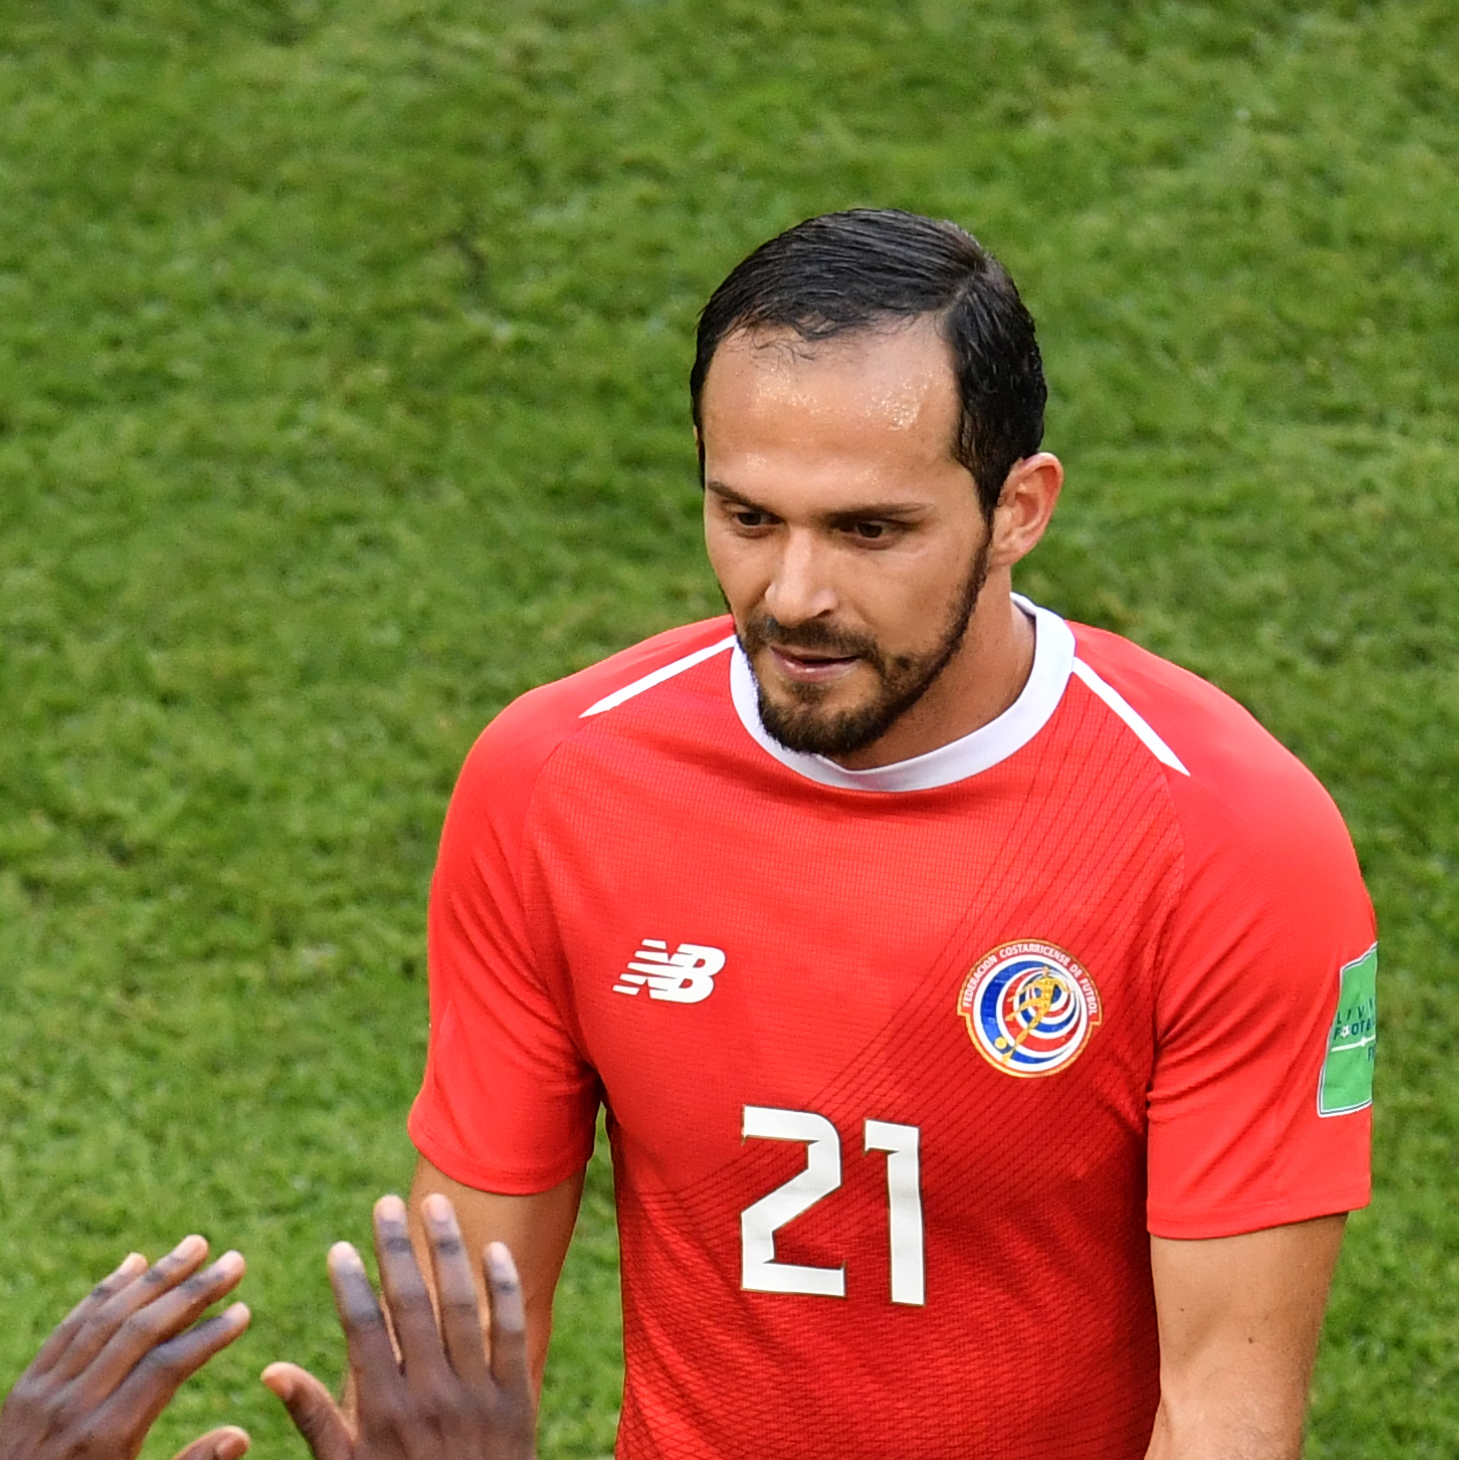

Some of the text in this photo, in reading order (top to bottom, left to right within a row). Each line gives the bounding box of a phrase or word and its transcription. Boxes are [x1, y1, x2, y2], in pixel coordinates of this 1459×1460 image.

[999, 943, 1070, 966] COSTARRICENSE
[1070, 965, 1083, 978] DE
[1079, 978, 1097, 1015] FUTBOL
[741, 1104, 926, 1308] 21
